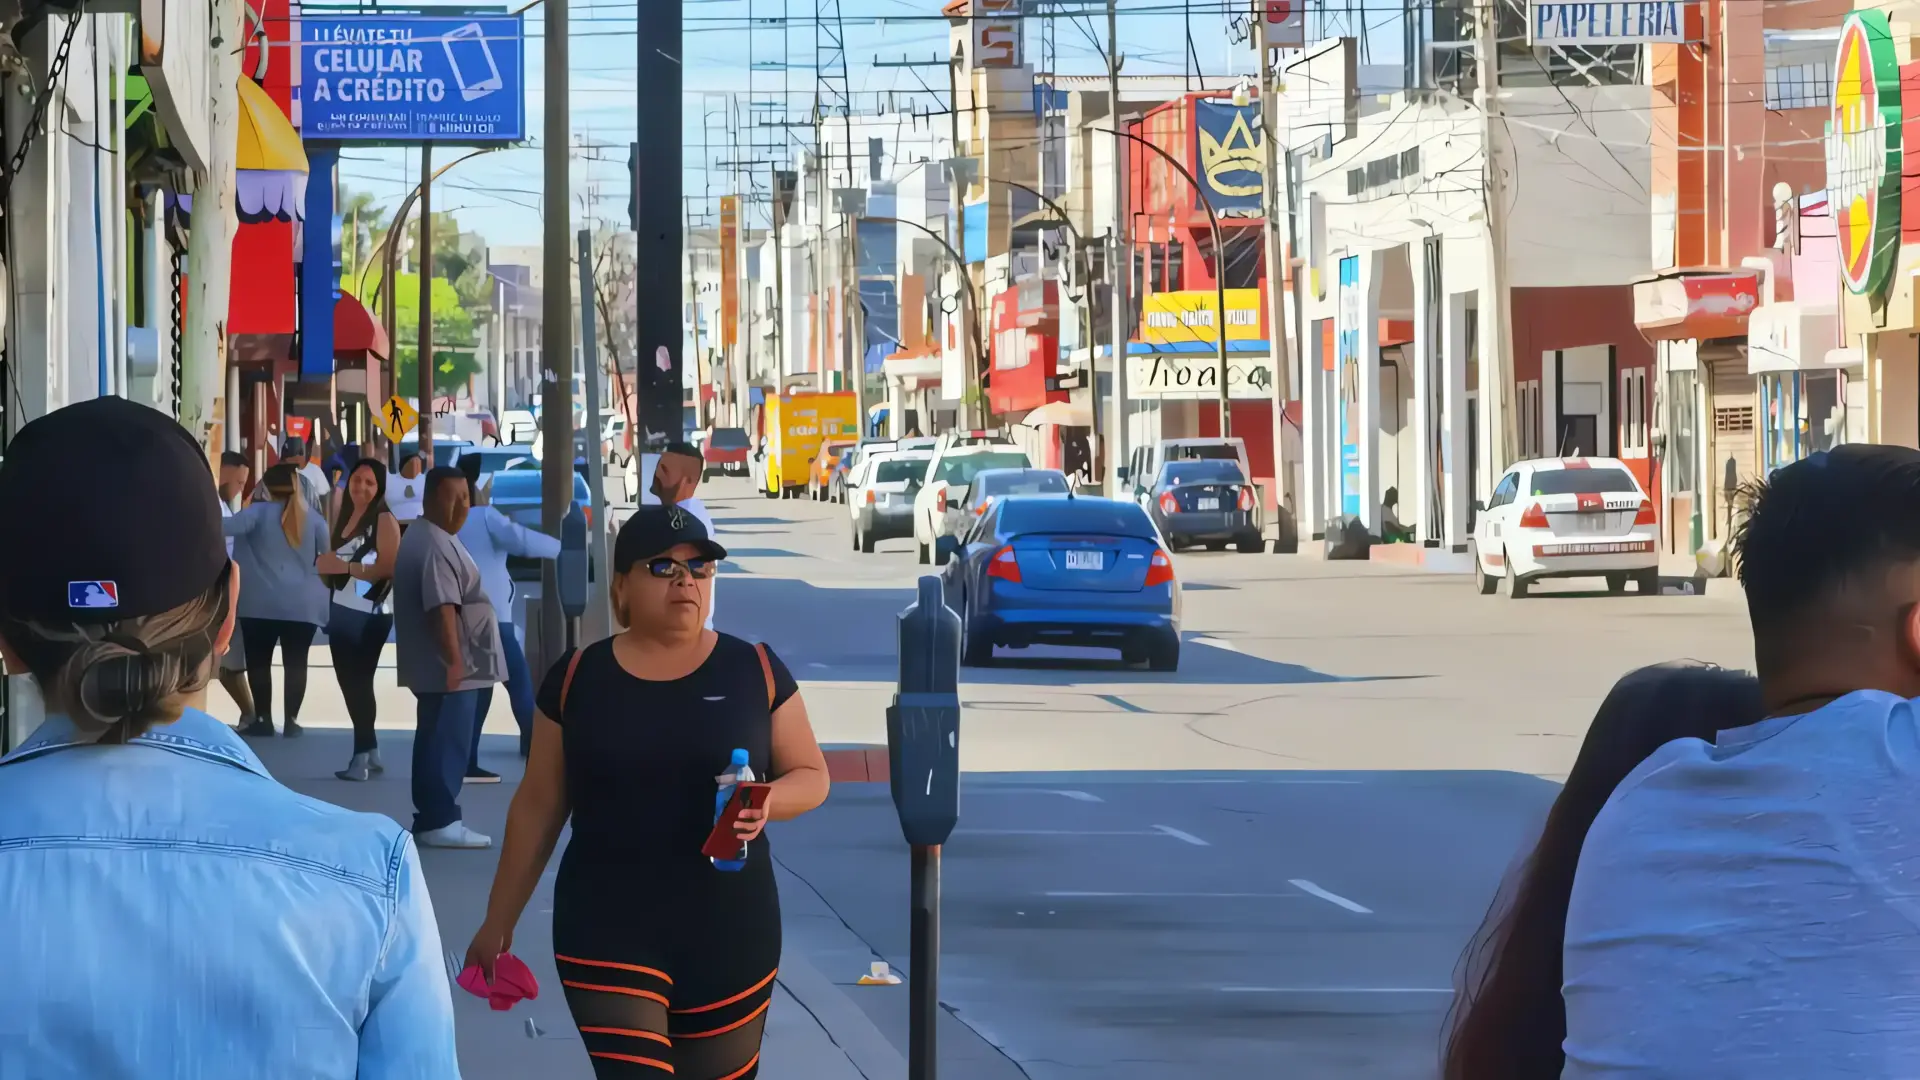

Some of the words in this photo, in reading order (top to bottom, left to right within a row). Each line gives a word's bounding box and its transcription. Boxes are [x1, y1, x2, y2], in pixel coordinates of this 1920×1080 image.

[1537, 1, 1678, 39] PAPELERIA
[390, 28, 413, 46] TU
[314, 48, 423, 73] CELULAR
[313, 78, 331, 102] A
[337, 72, 445, 102] CRÉDITO
